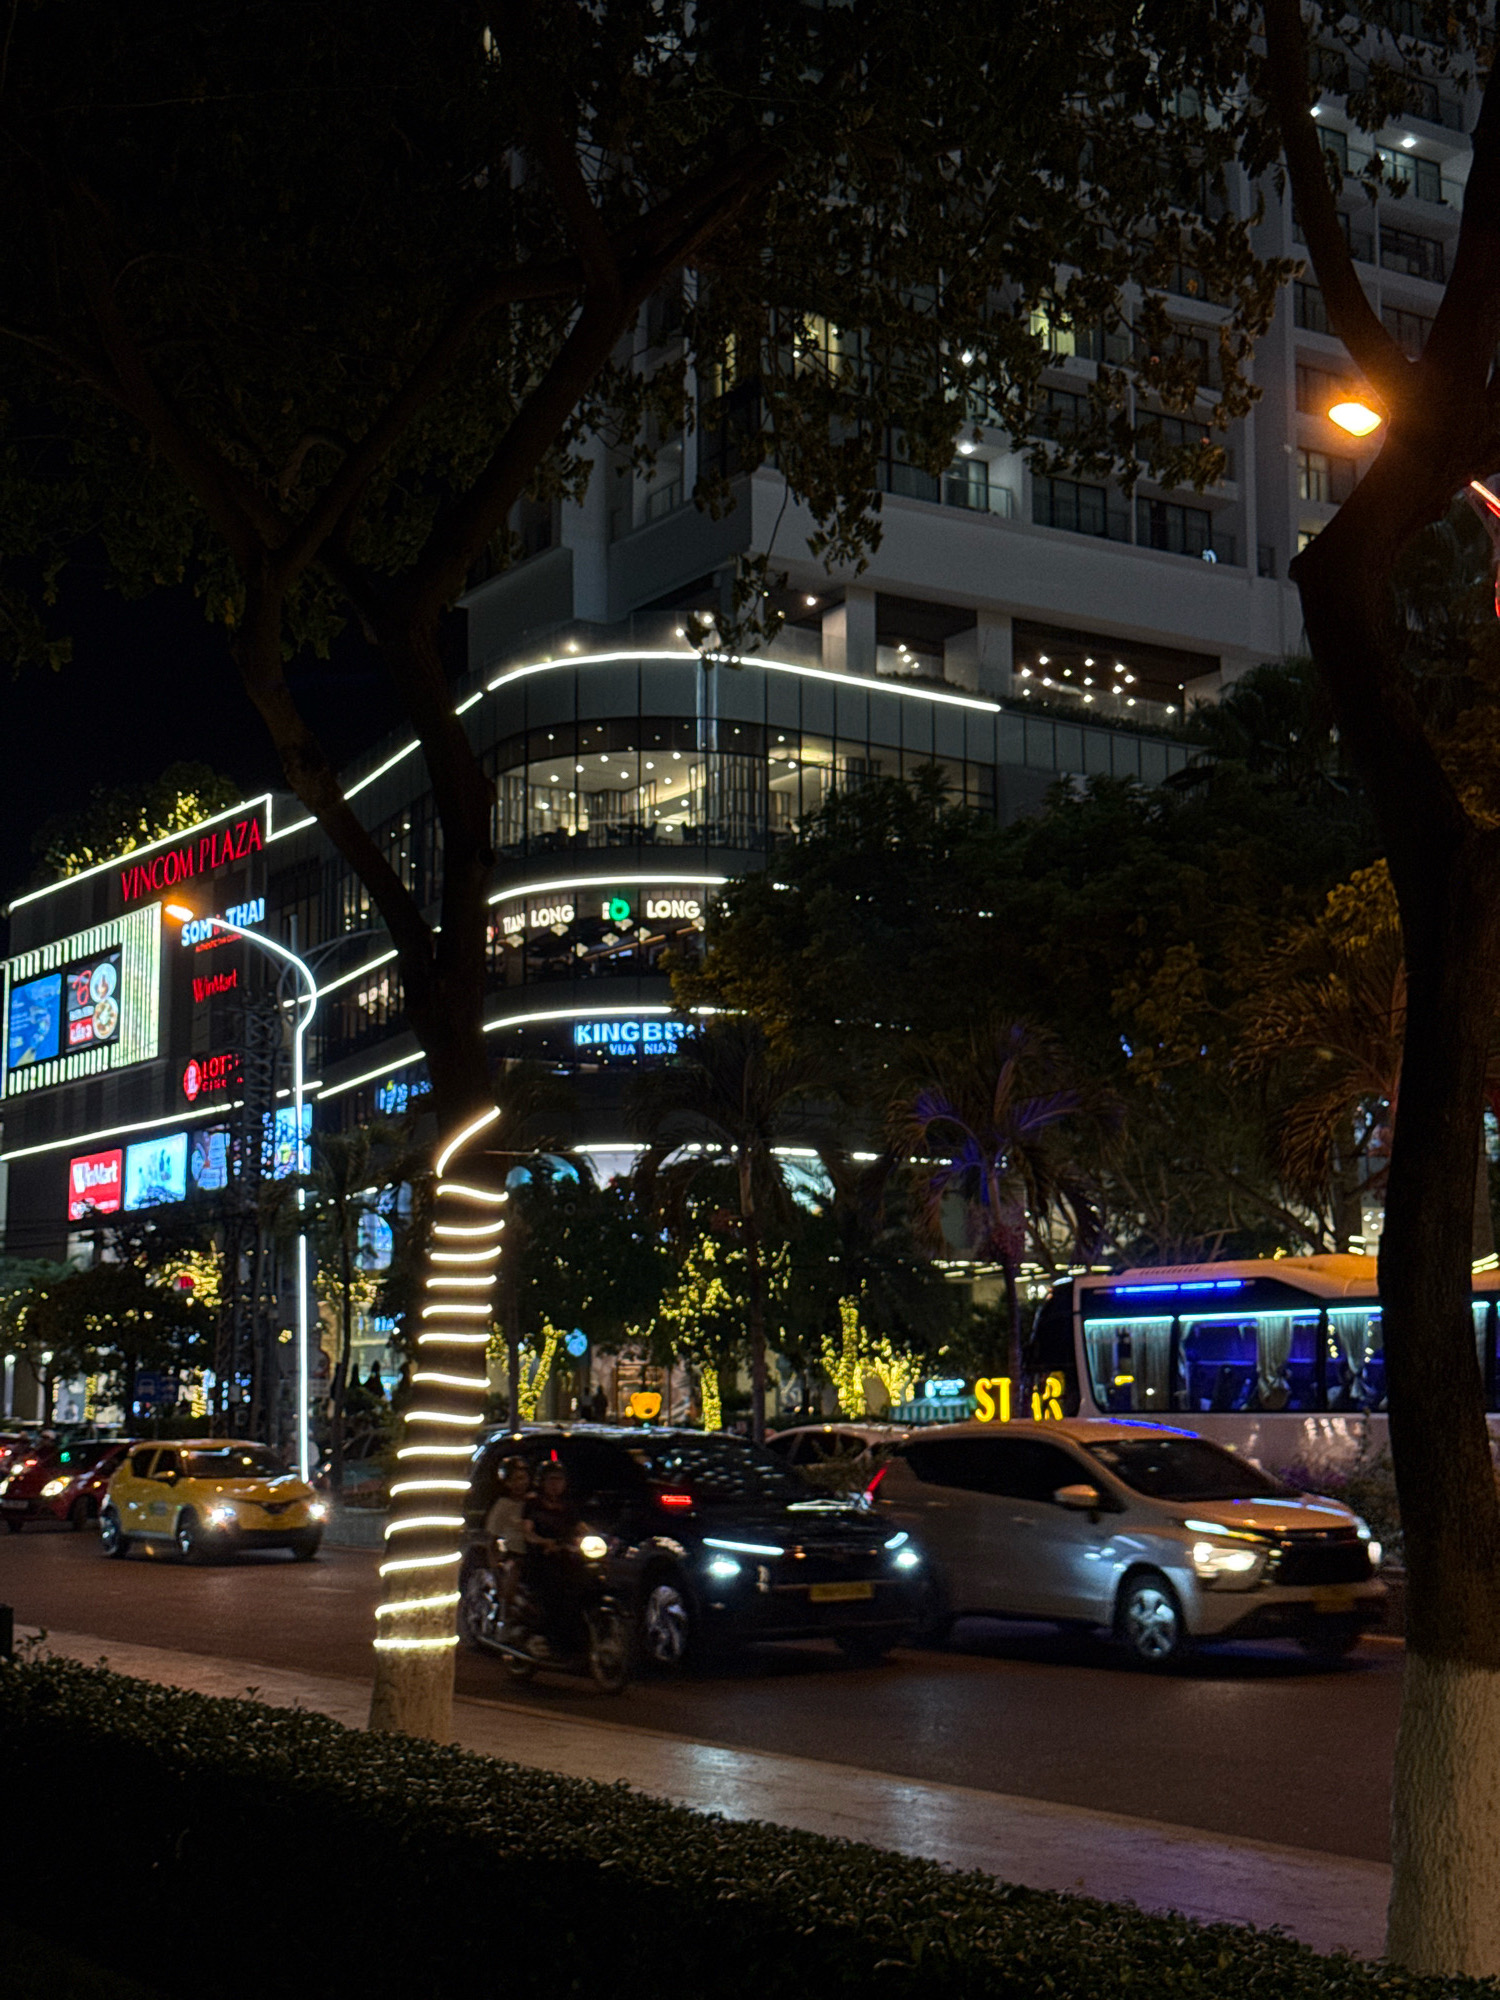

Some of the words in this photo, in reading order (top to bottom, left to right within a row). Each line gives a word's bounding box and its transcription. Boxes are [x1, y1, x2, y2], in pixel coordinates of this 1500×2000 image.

[121, 845, 195, 902] VINCOM
[198, 817, 263, 873] PLAZA
[181, 918, 213, 947] SOM
[225, 897, 265, 927] THAI
[530, 904, 575, 927] LONG
[646, 900, 701, 919] LONG
[192, 968, 238, 1003] WinMart
